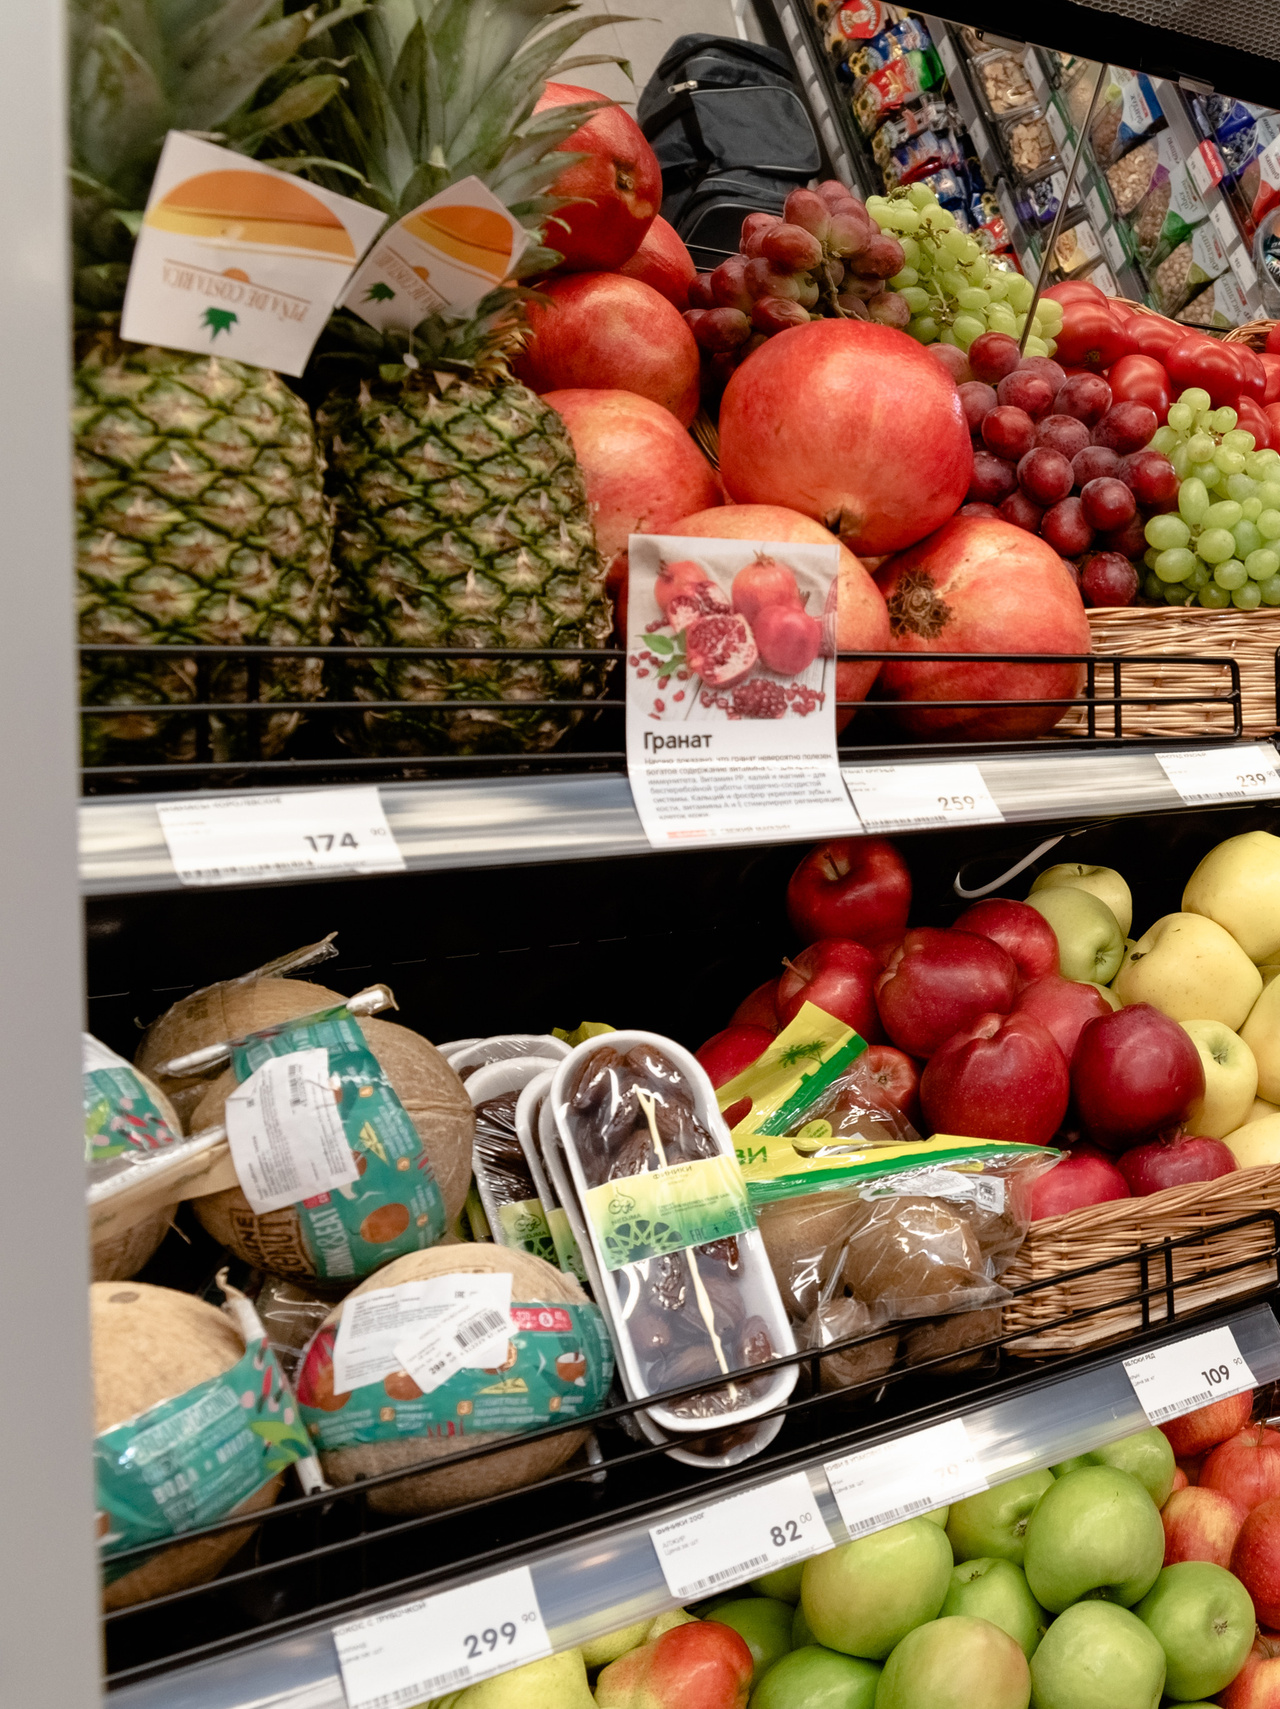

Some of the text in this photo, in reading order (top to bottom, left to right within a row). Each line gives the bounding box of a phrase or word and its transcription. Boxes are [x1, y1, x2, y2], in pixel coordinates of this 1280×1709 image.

[644, 731, 713, 754] Гранат
[1236, 773, 1266, 788] 239
[937, 795, 975, 811] 259
[303, 832, 359, 852] 174
[1233, 1356, 1243, 1366] 90
[1201, 1365, 1230, 1387] 109
[799, 1512, 812, 1524] 00
[656, 1519, 688, 1535] ФИНИКИ
[770, 1520, 802, 1547] 82
[521, 1612, 537, 1623] 90
[463, 1622, 517, 1659] 299
